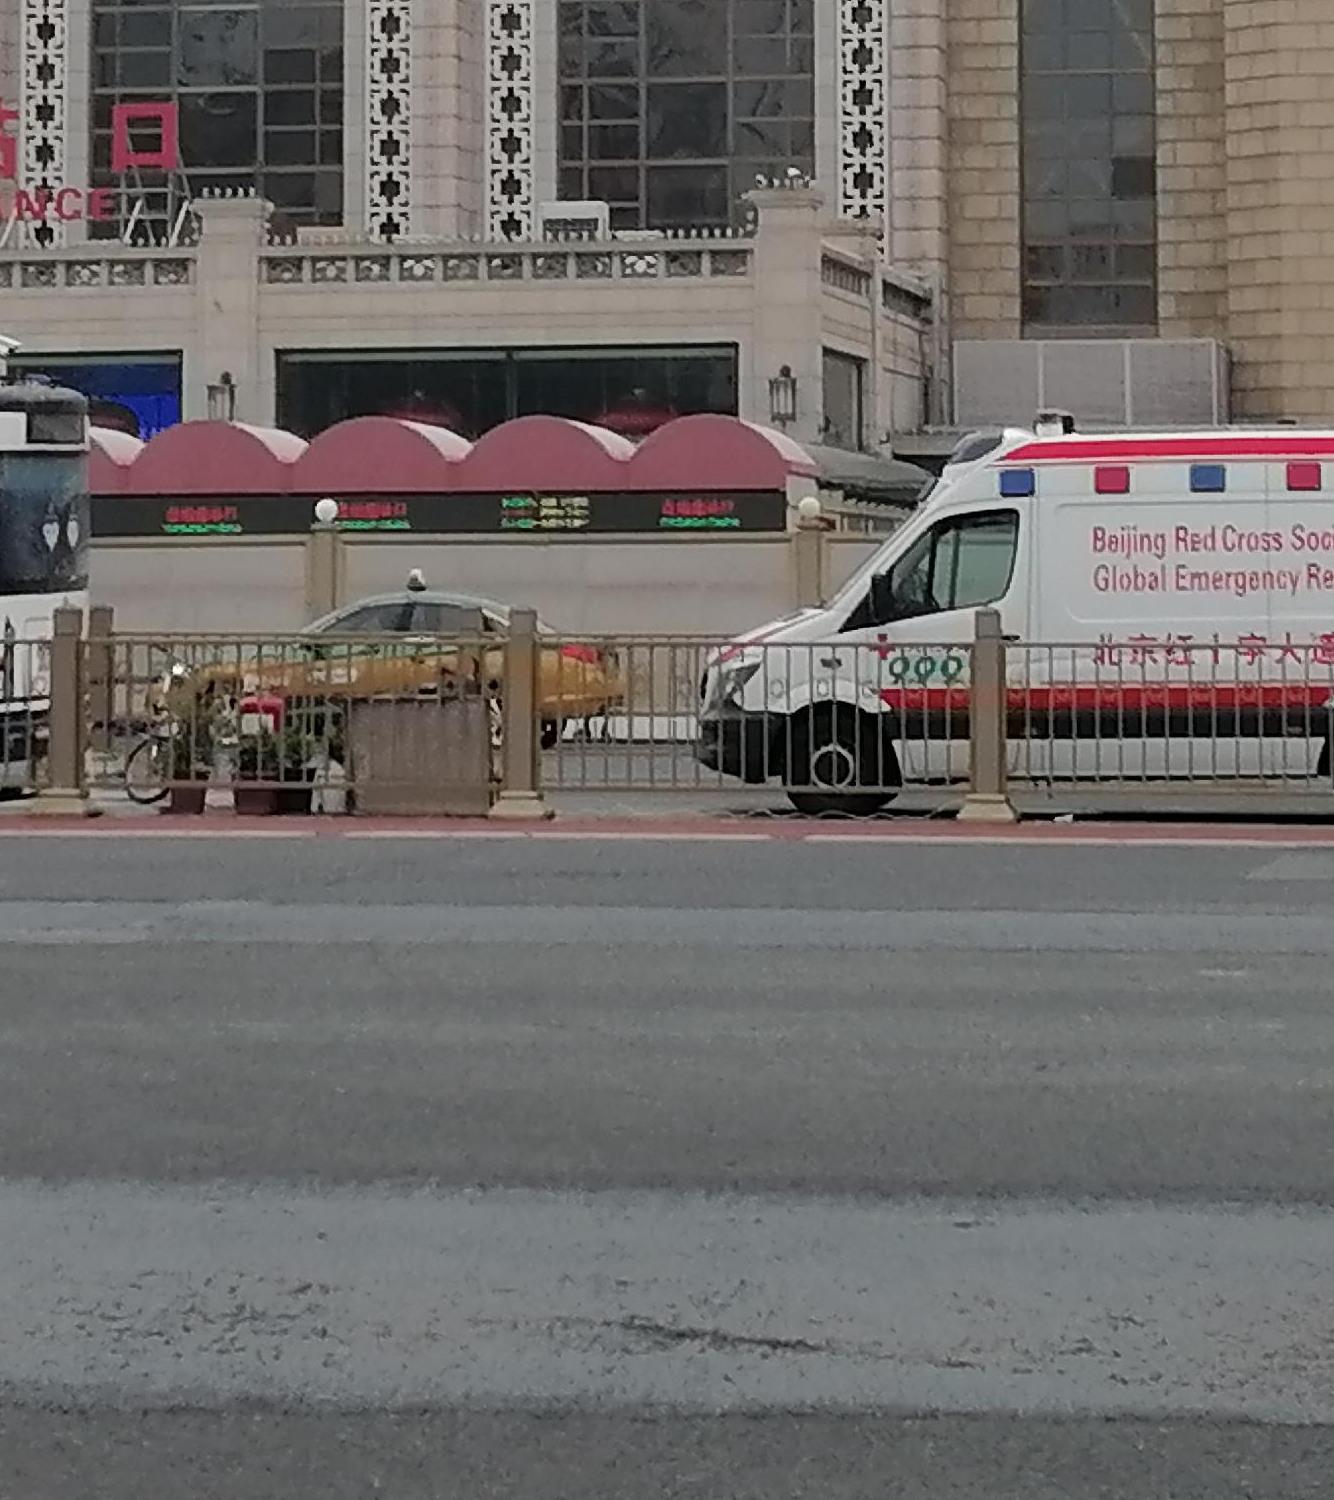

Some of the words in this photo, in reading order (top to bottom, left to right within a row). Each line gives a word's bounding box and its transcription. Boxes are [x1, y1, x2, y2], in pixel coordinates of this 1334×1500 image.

[1092, 525, 1167, 560] Beijing
[1175, 524, 1216, 552] Red
[1221, 524, 1283, 552] Cross
[1093, 564, 1167, 592] Global
[1175, 564, 1299, 597] Emergency
